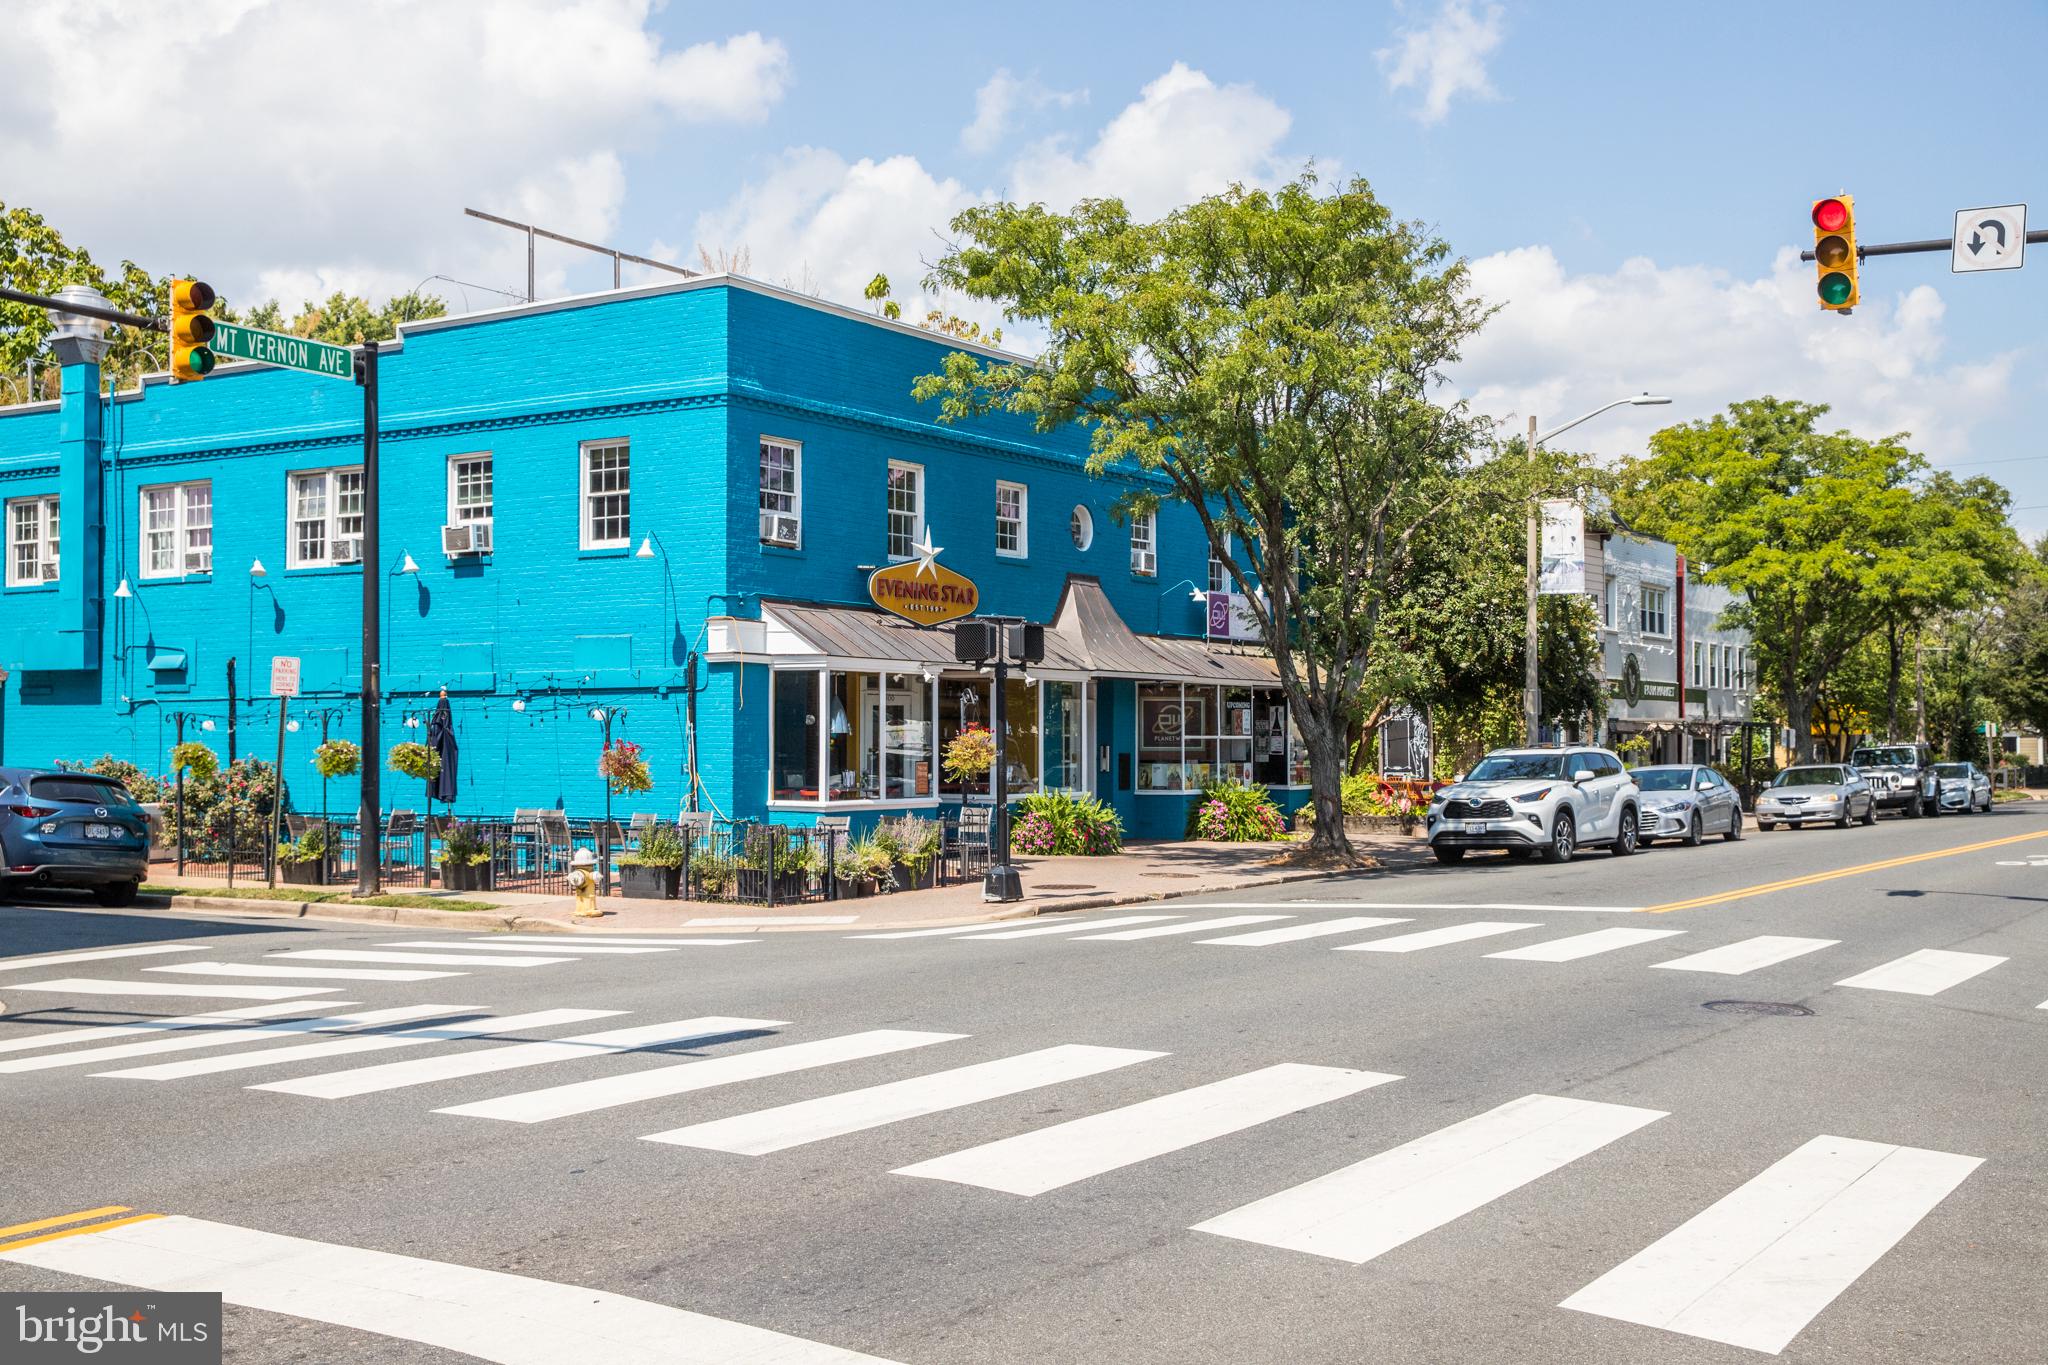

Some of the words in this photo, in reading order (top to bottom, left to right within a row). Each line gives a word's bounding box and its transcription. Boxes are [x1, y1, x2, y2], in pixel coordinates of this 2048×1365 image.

[216, 326, 237, 353] MT
[247, 332, 308, 367] VERNON
[319, 348, 345, 374] AVE
[876, 578, 939, 602] EVENING
[941, 585, 974, 605] STAR
